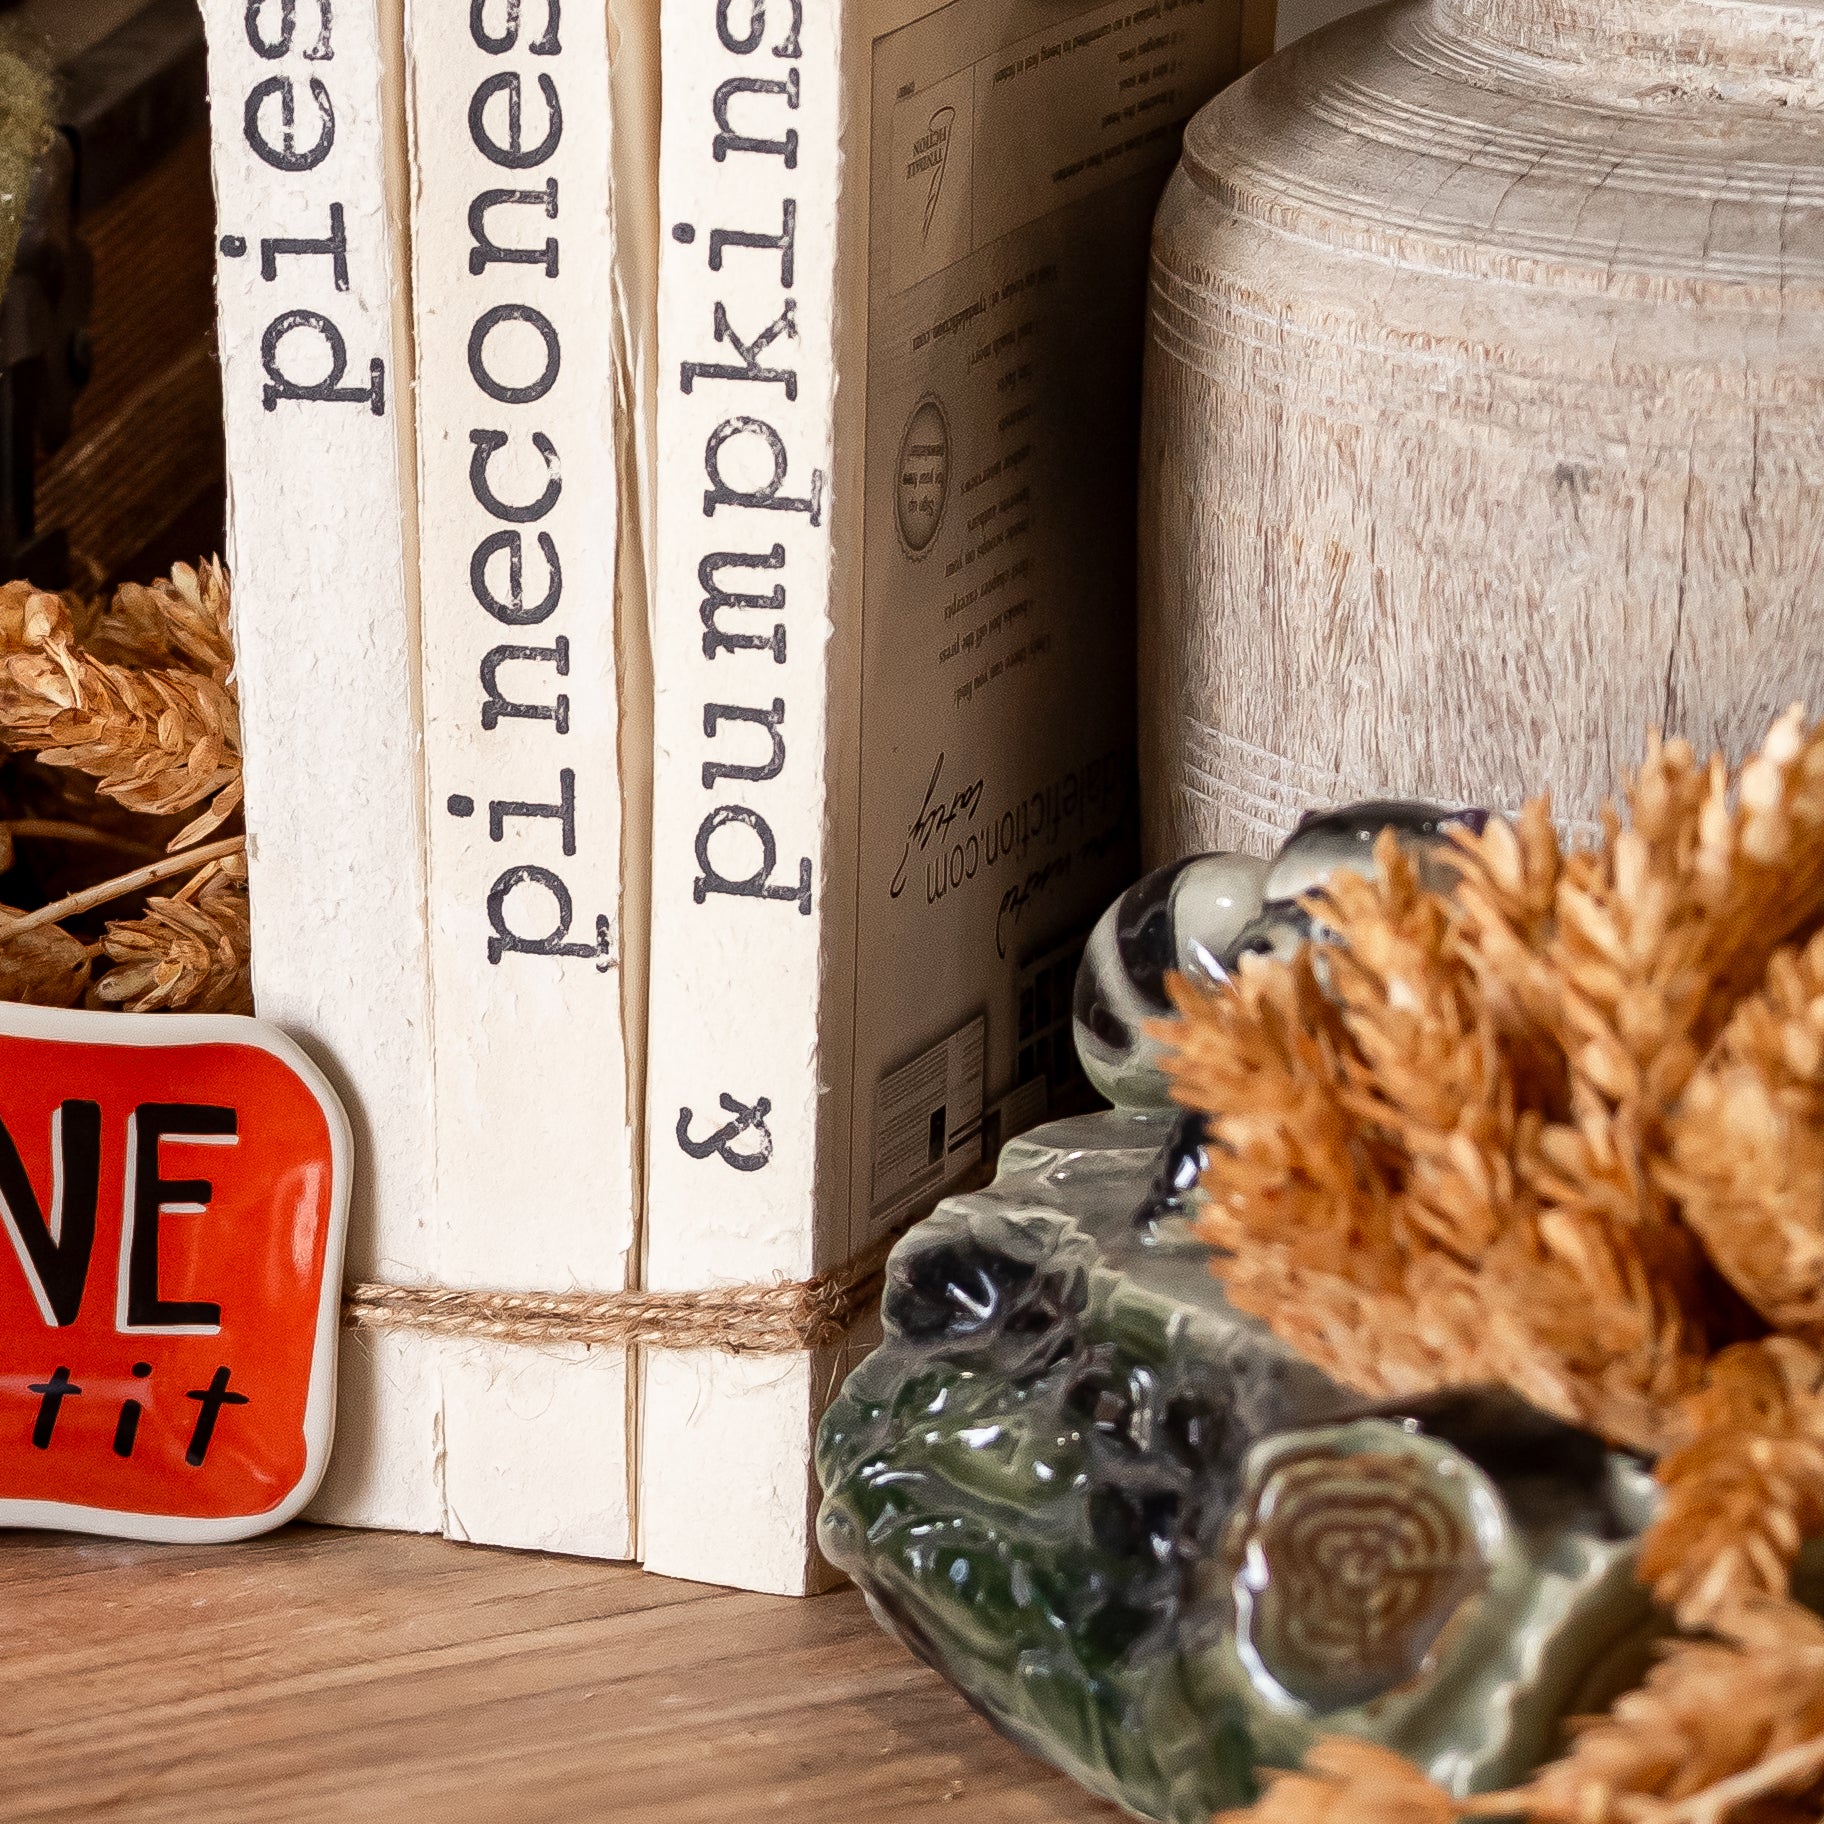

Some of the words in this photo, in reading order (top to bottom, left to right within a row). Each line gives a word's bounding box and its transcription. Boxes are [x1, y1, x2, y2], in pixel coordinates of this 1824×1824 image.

[911, 126, 947, 158] FICTION
[926, 749, 1119, 905] dalefiction.com
[676, 1092, 773, 1172] &
